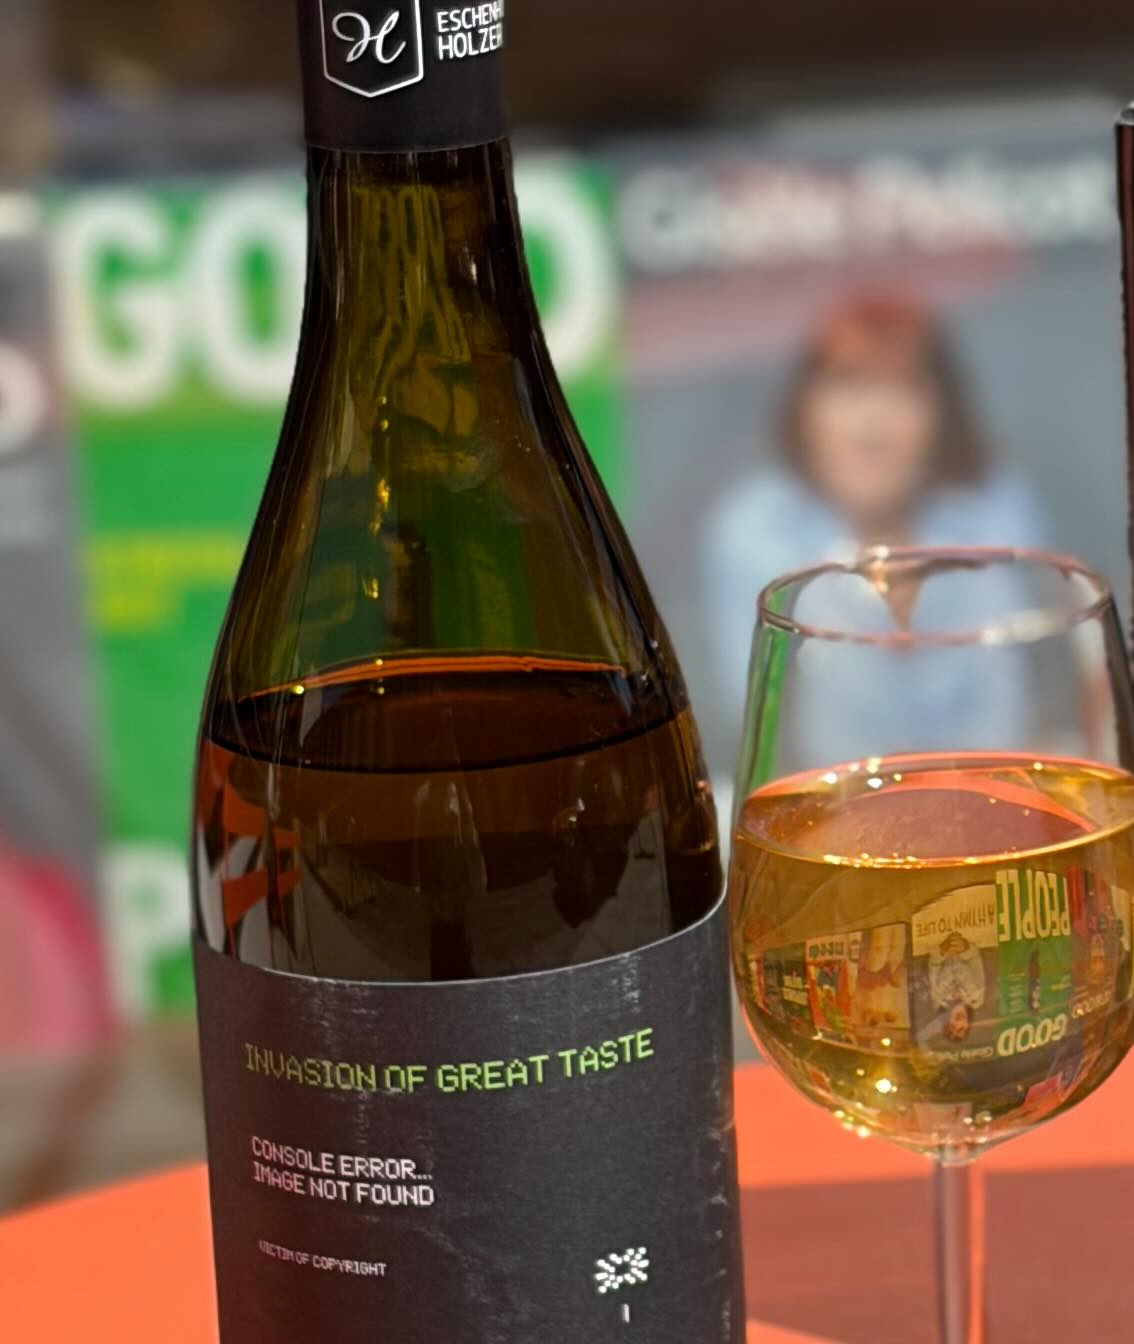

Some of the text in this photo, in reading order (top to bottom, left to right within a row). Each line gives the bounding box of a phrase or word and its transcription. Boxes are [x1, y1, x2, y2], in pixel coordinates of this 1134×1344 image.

[50, 159, 622, 411] GOD
[245, 1028, 654, 1093] INVASION OF GREAT TASTE
[252, 1135, 433, 1181] CONSOLE ERROR...
[252, 1161, 434, 1206] IMAGE NOT FOUND
[312, 1253, 387, 1277] COPYRIGHT
